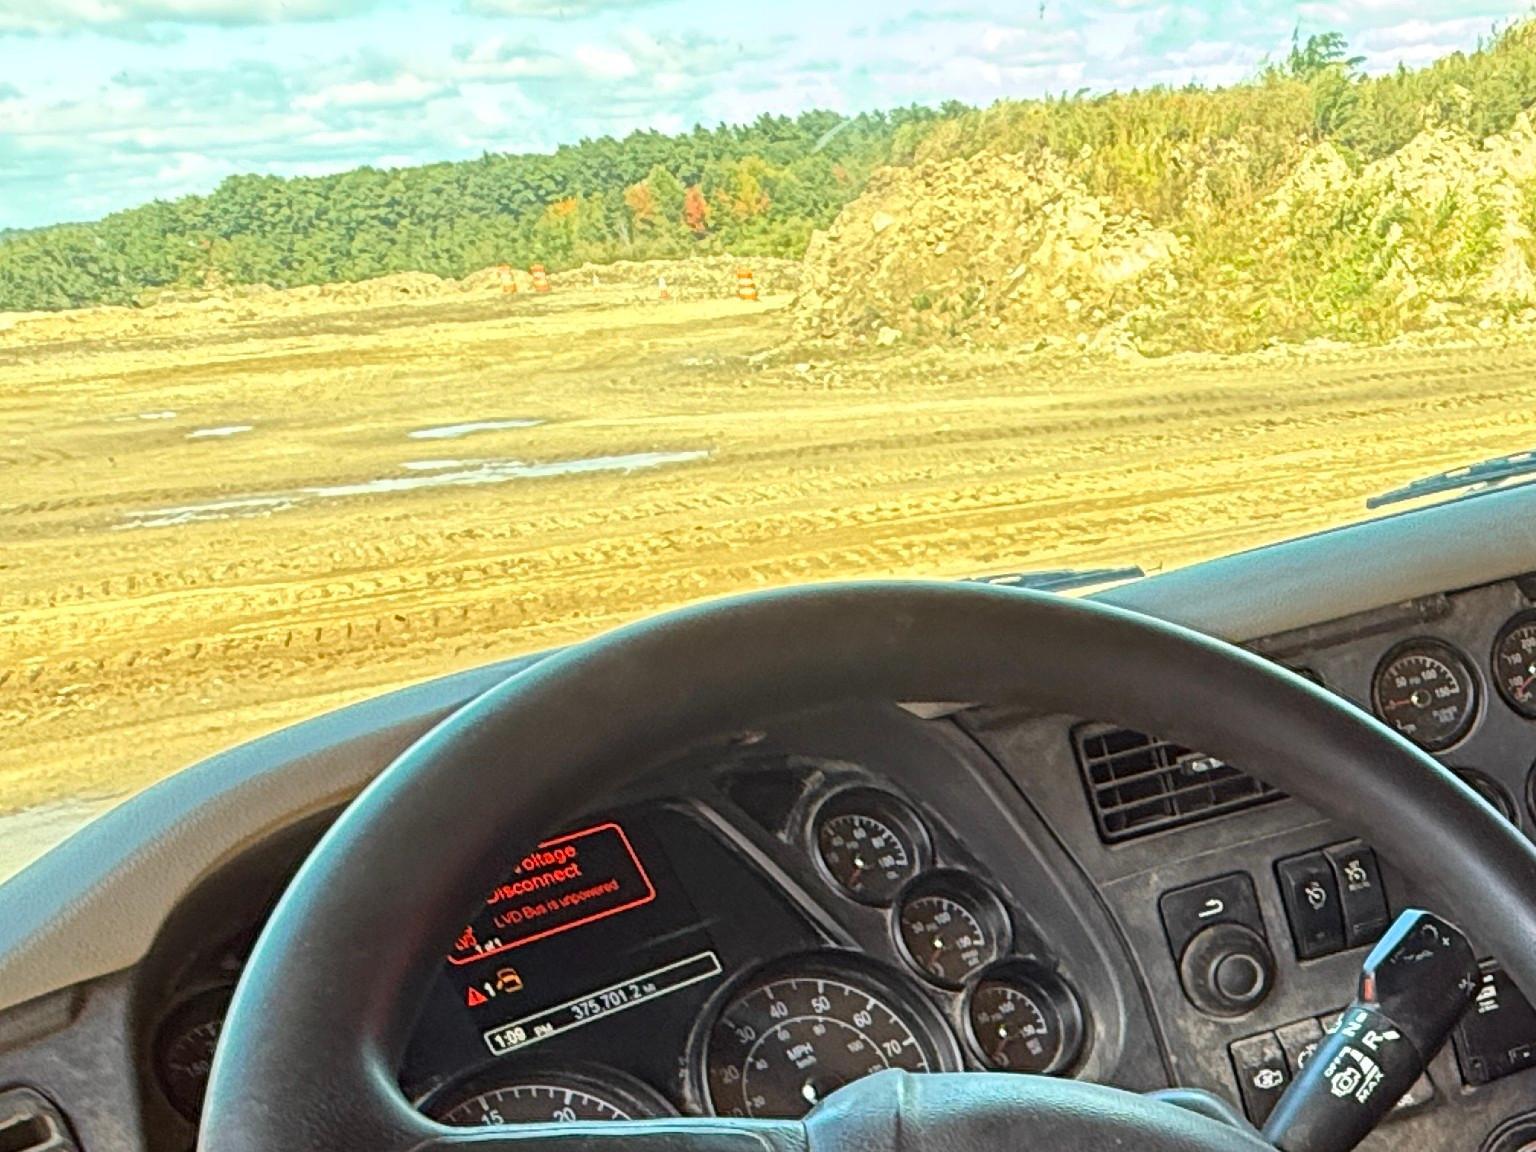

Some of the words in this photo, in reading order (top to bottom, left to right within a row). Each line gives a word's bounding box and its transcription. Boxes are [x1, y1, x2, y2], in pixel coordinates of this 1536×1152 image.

[513, 845, 577, 874] oltage
[770, 1001, 788, 1018] 40
[811, 996, 830, 1014] 50
[853, 1010, 872, 1028] 60
[495, 1027, 527, 1048] 1:09
[736, 1025, 756, 1044] 30
[883, 1039, 902, 1057] 70
